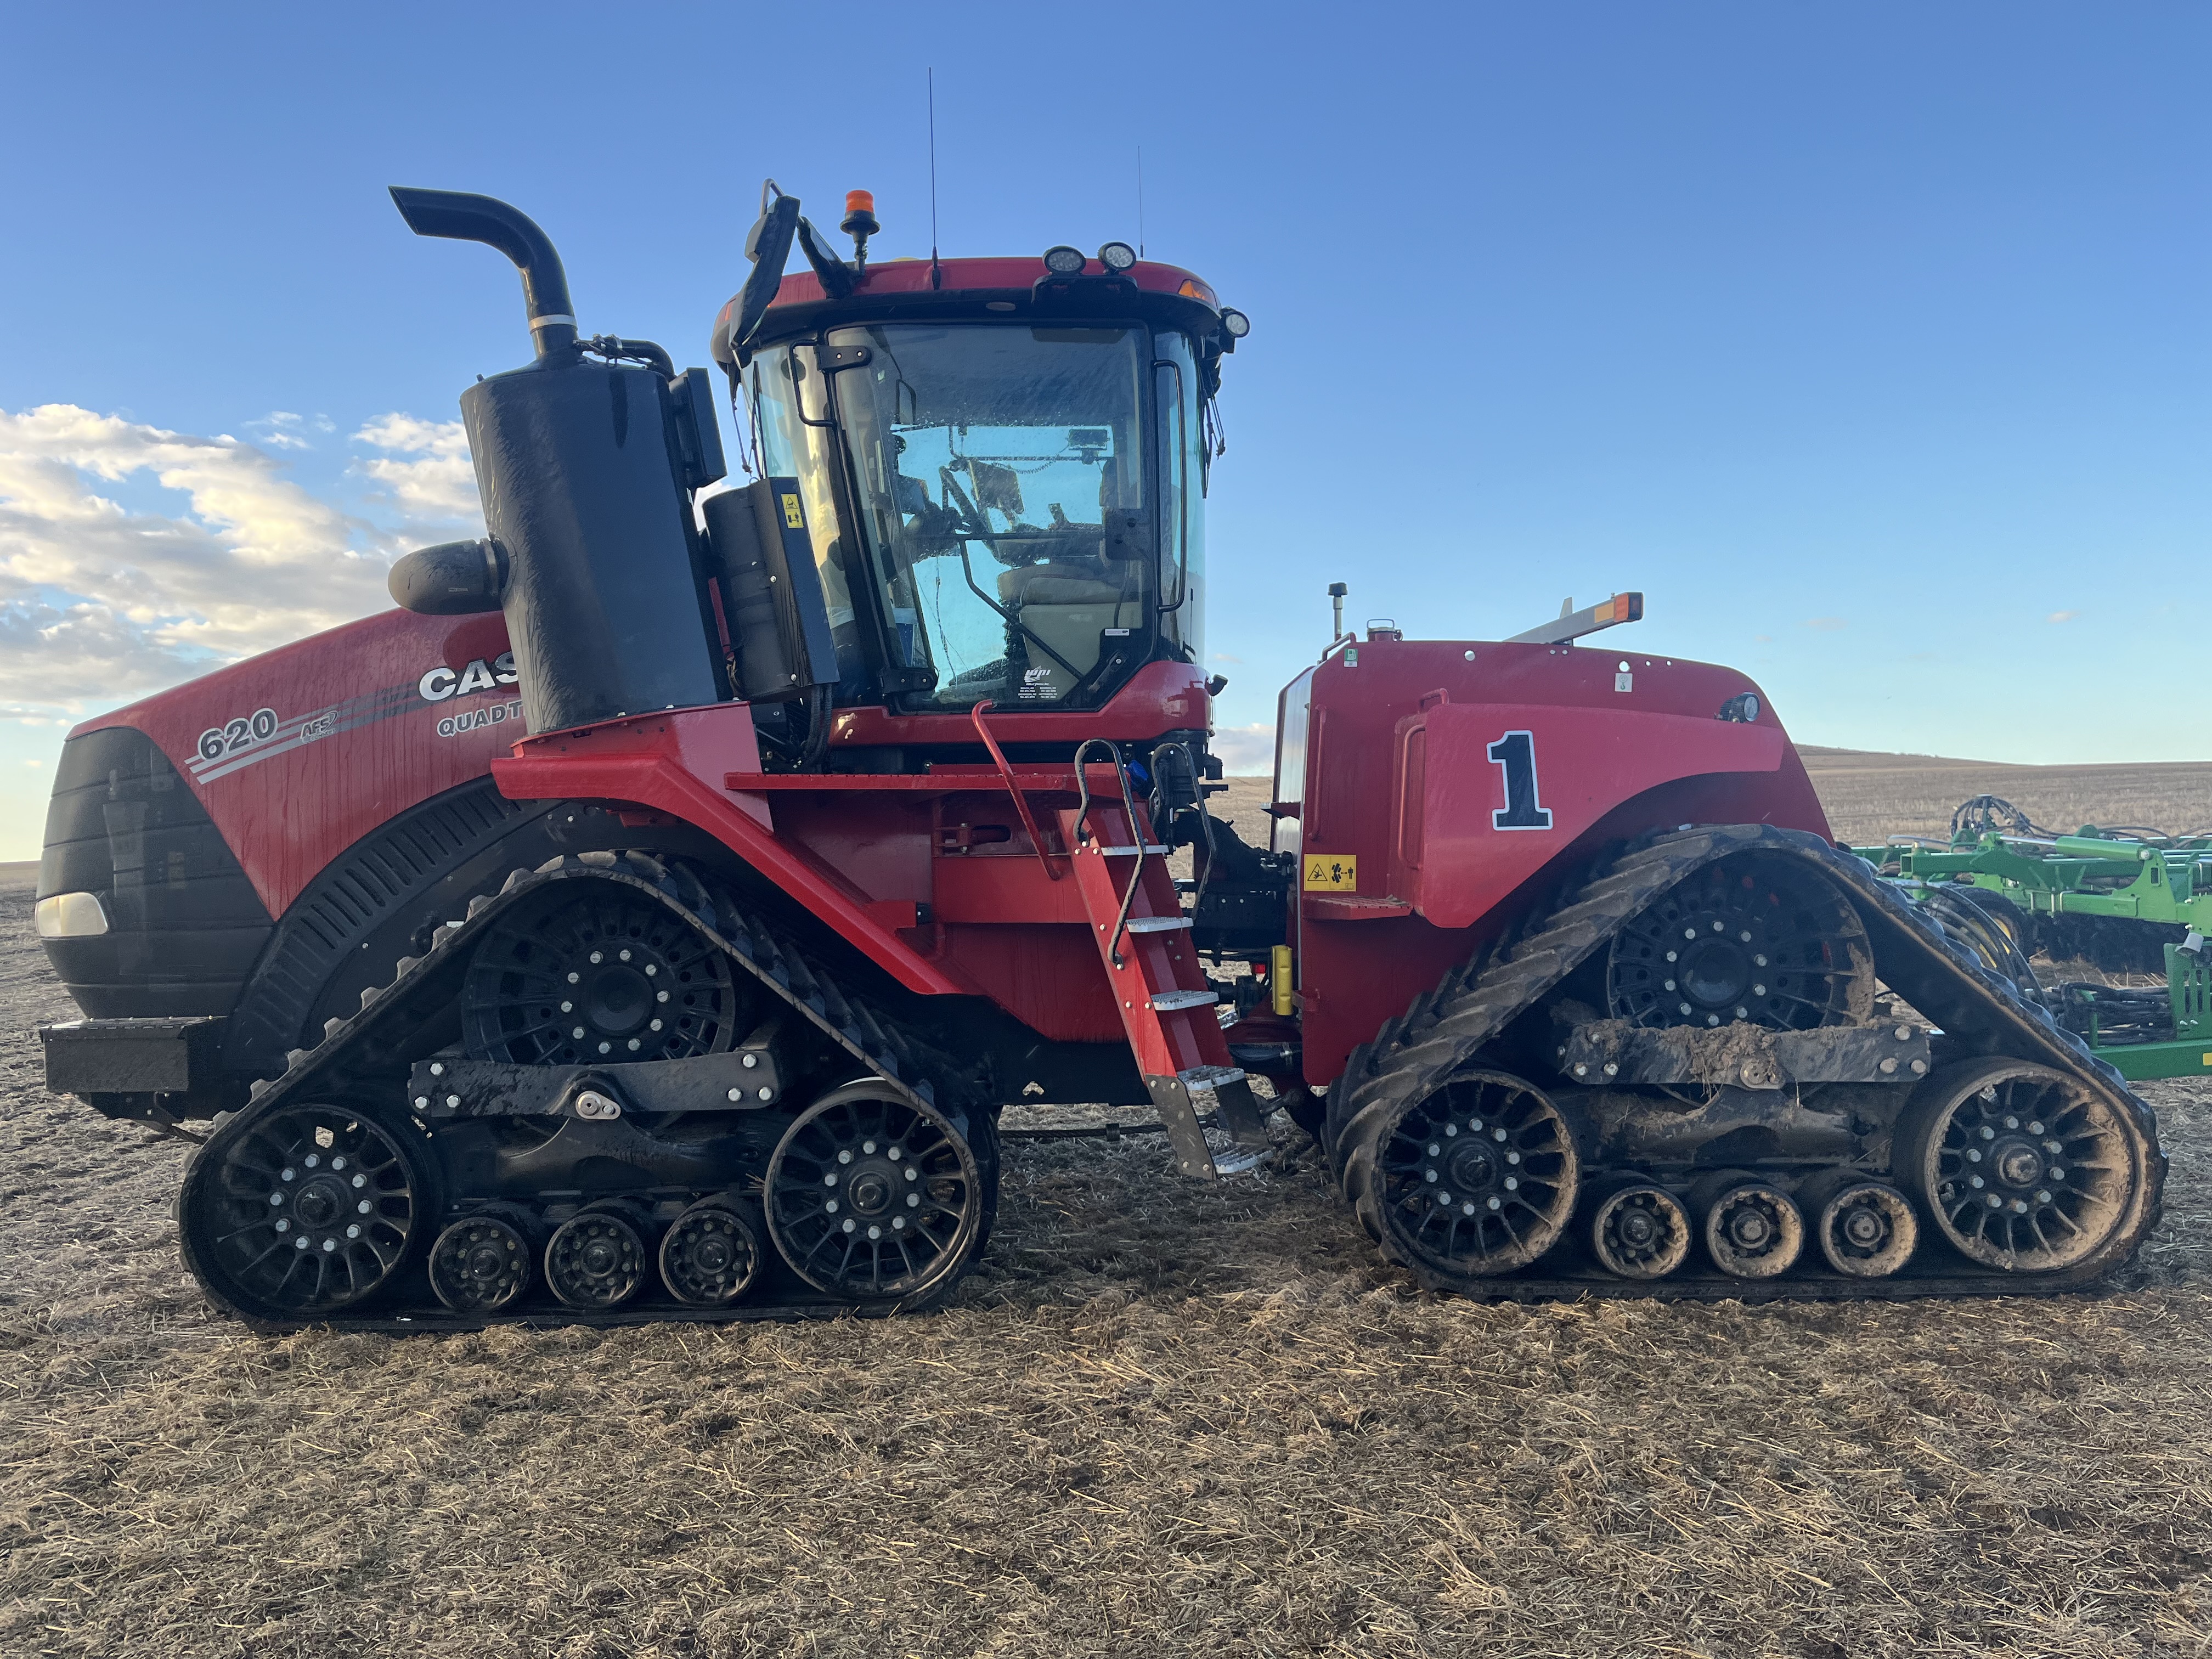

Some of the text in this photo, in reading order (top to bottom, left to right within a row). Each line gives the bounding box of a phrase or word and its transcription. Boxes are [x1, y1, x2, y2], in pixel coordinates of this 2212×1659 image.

[419, 651, 518, 701] CAS
[198, 707, 278, 761] 620
[300, 713, 334, 739] AFS
[437, 699, 525, 737] QUADT
[1486, 730, 1553, 831] 1
